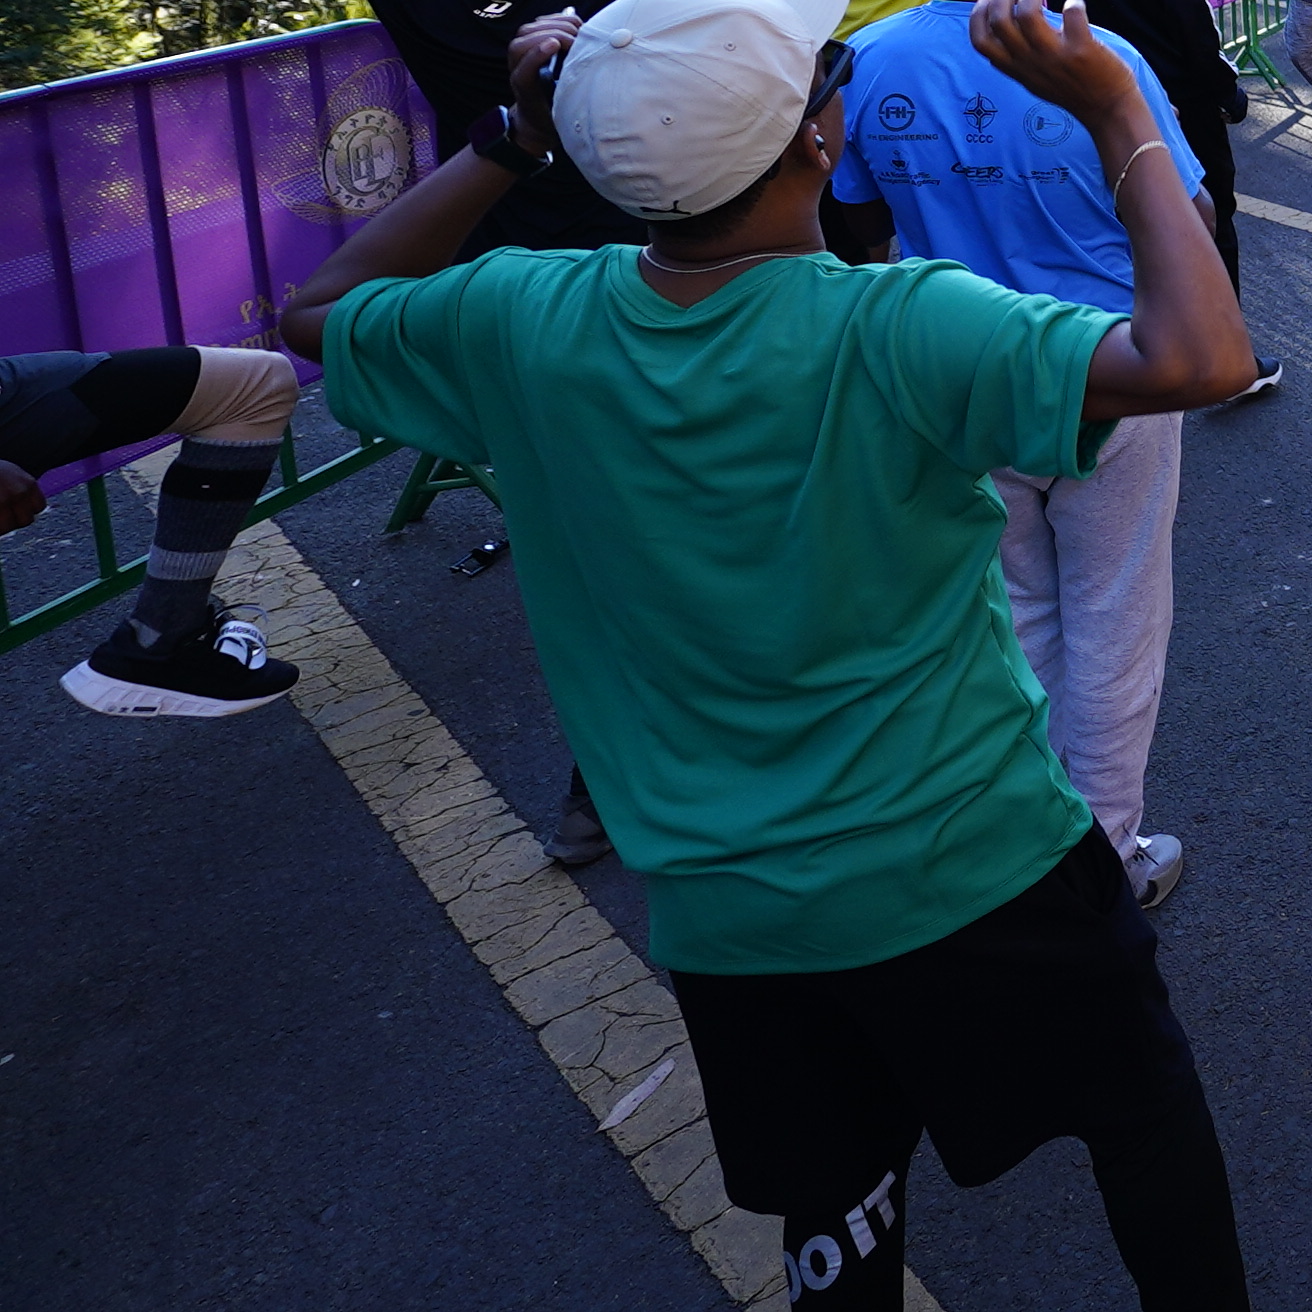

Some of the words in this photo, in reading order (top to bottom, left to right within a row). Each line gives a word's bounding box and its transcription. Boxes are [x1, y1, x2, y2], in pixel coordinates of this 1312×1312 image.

[878, 133, 939, 142] ENGINEERING
[965, 134, 994, 144] CCCC
[845, 1169, 897, 1260] IT
